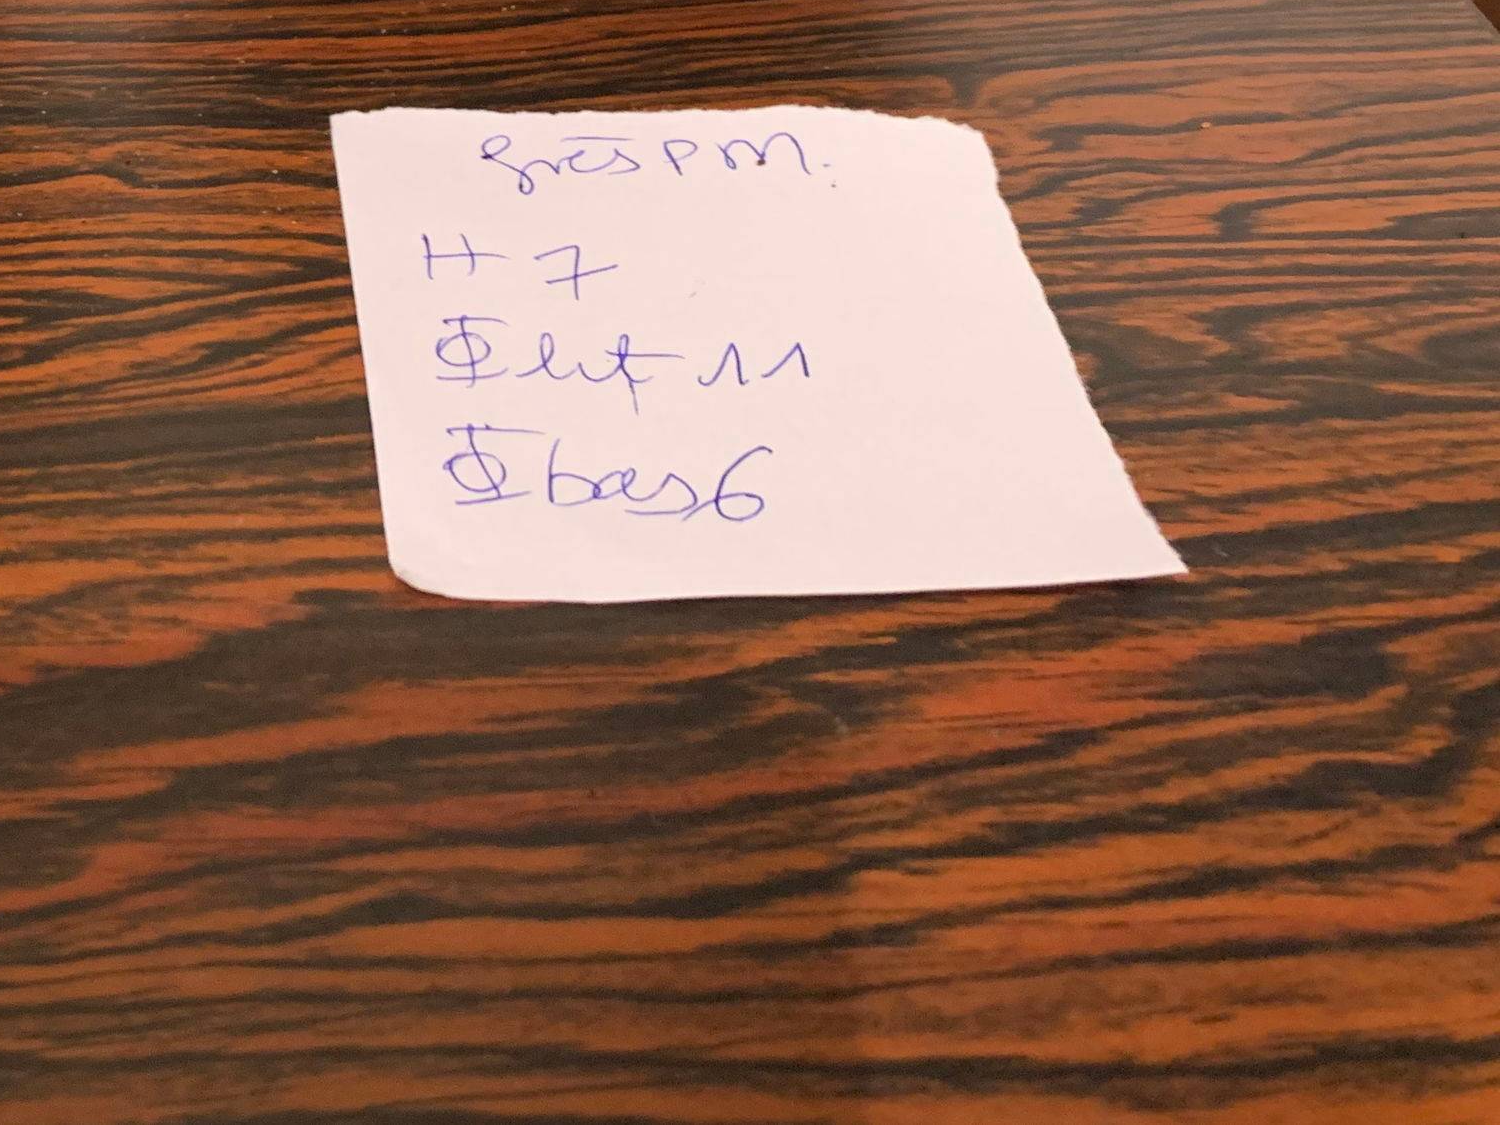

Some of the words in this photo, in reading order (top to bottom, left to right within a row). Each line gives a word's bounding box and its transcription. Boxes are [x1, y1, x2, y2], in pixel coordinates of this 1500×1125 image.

[422, 233, 510, 280] H
[534, 244, 619, 301] 7
[697, 342, 810, 387] 11
[680, 445, 774, 522] 6
